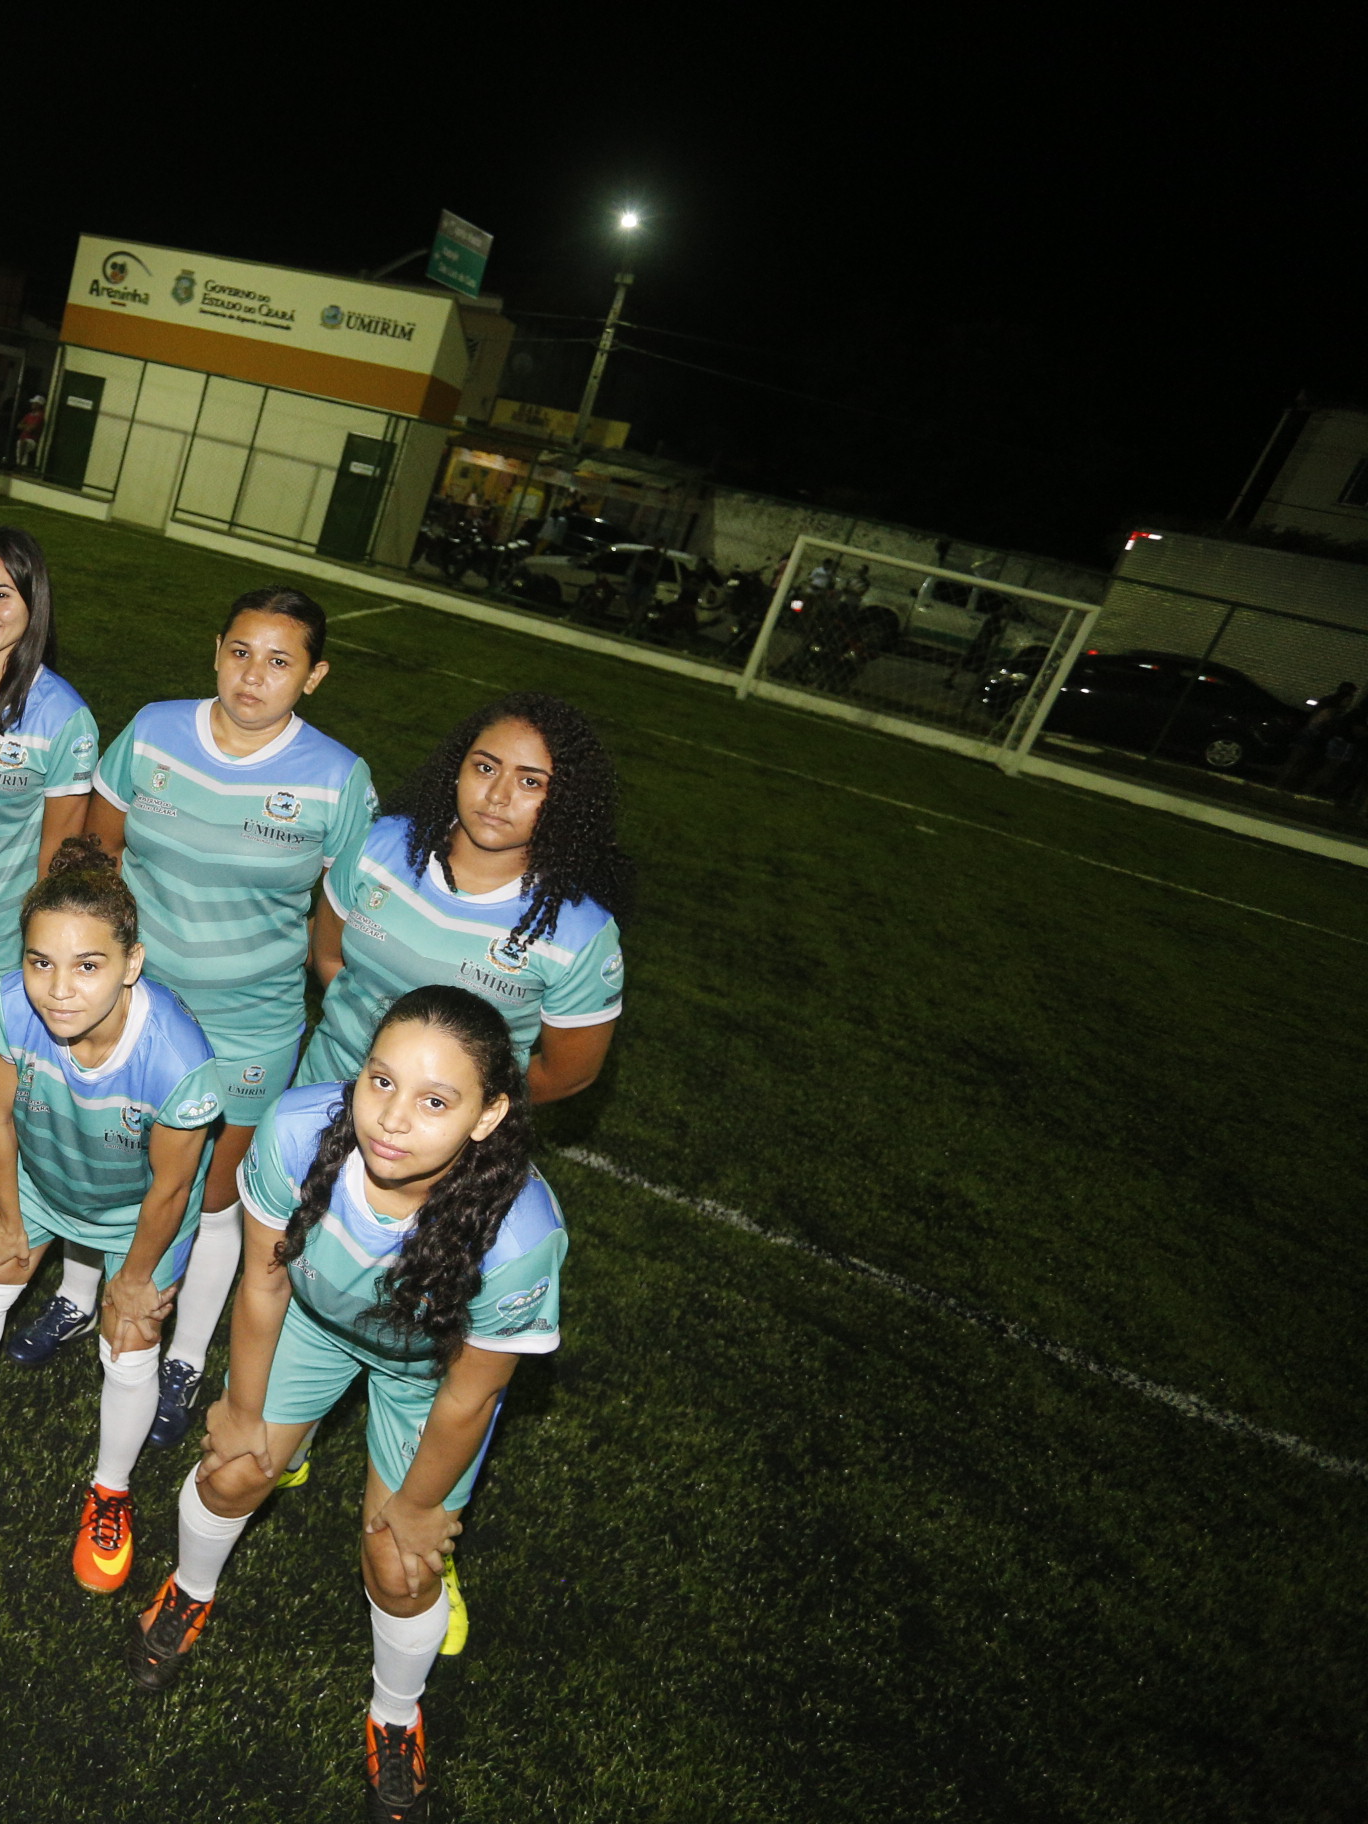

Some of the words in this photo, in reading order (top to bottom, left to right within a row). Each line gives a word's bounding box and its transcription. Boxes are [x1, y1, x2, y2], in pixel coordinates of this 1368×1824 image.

[89, 279, 150, 306] Areninha
[203, 279, 257, 302] GOVERNO
[201, 292, 242, 312] ESTADO
[257, 304, 296, 323] CEARÁ
[346, 314, 415, 341] UMIRIM
[460, 962, 527, 999] UMIRIM
[228, 1085, 266, 1096] UMIRIM
